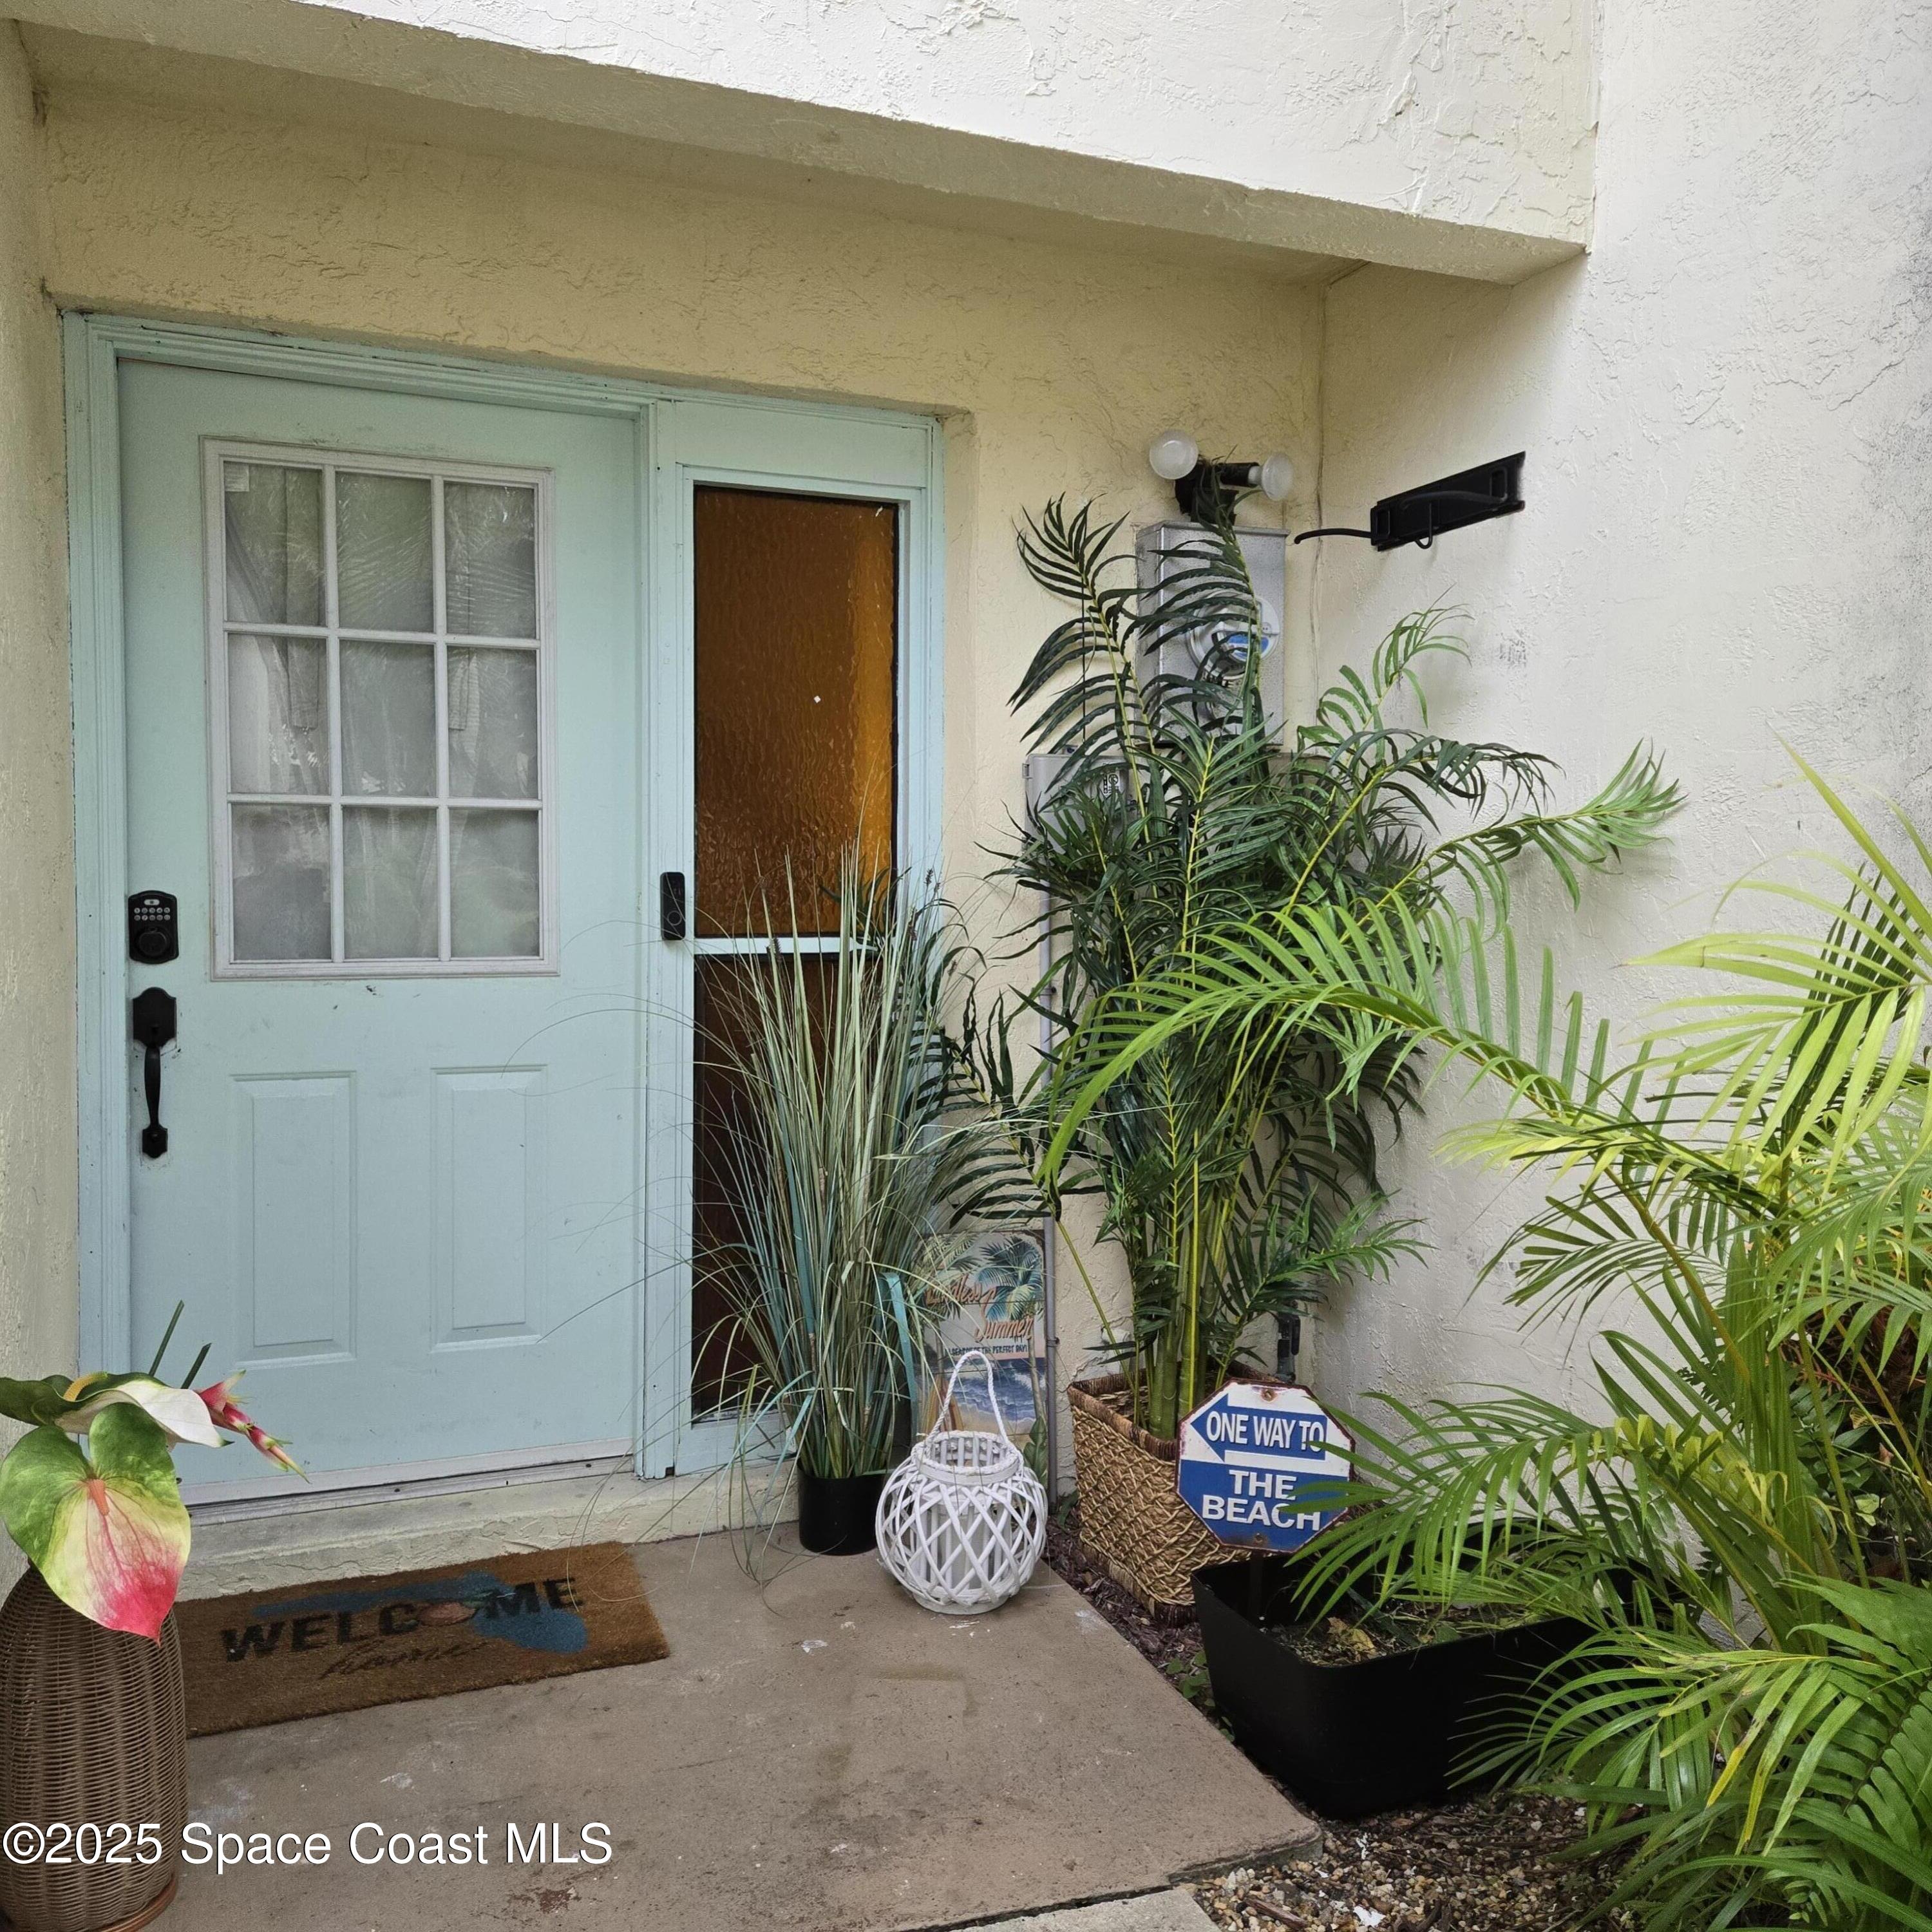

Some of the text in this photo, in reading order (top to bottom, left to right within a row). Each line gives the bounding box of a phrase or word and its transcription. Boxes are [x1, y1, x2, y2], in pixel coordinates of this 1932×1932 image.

[974, 1287, 1034, 1343] Summer
[1206, 1411, 1325, 1452] ONE WAY TO
[1229, 1470, 1297, 1501] THE
[1202, 1495, 1321, 1531] BEACH
